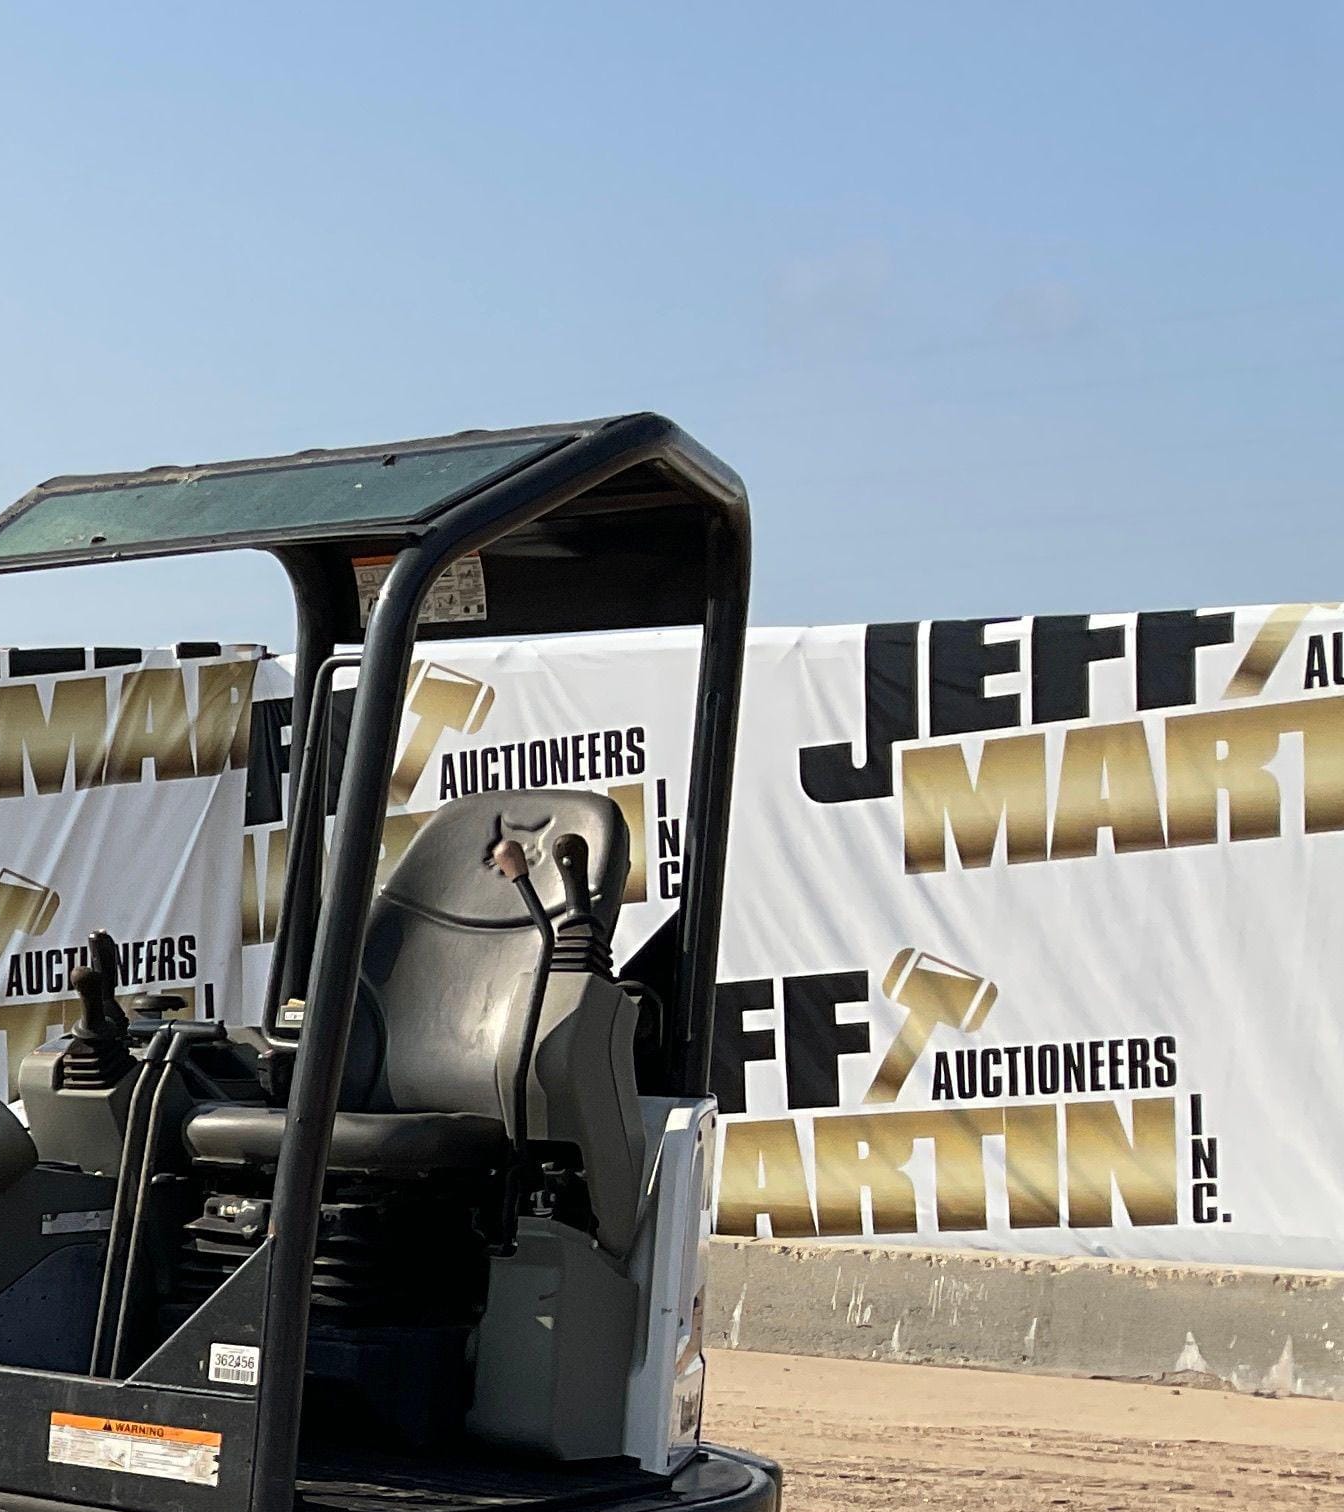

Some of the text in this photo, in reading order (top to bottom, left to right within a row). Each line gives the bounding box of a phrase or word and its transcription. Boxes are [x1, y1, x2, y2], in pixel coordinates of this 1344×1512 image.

[439, 726, 646, 800] AUCTIONEERS
[5, 935, 197, 997] AUCTINEERS
[710, 970, 871, 1114] FF
[932, 1035, 1178, 1101] AUCTIONEERS
[715, 1097, 1178, 1238] ARTIN
[115, 1422, 165, 1438] WARNING
